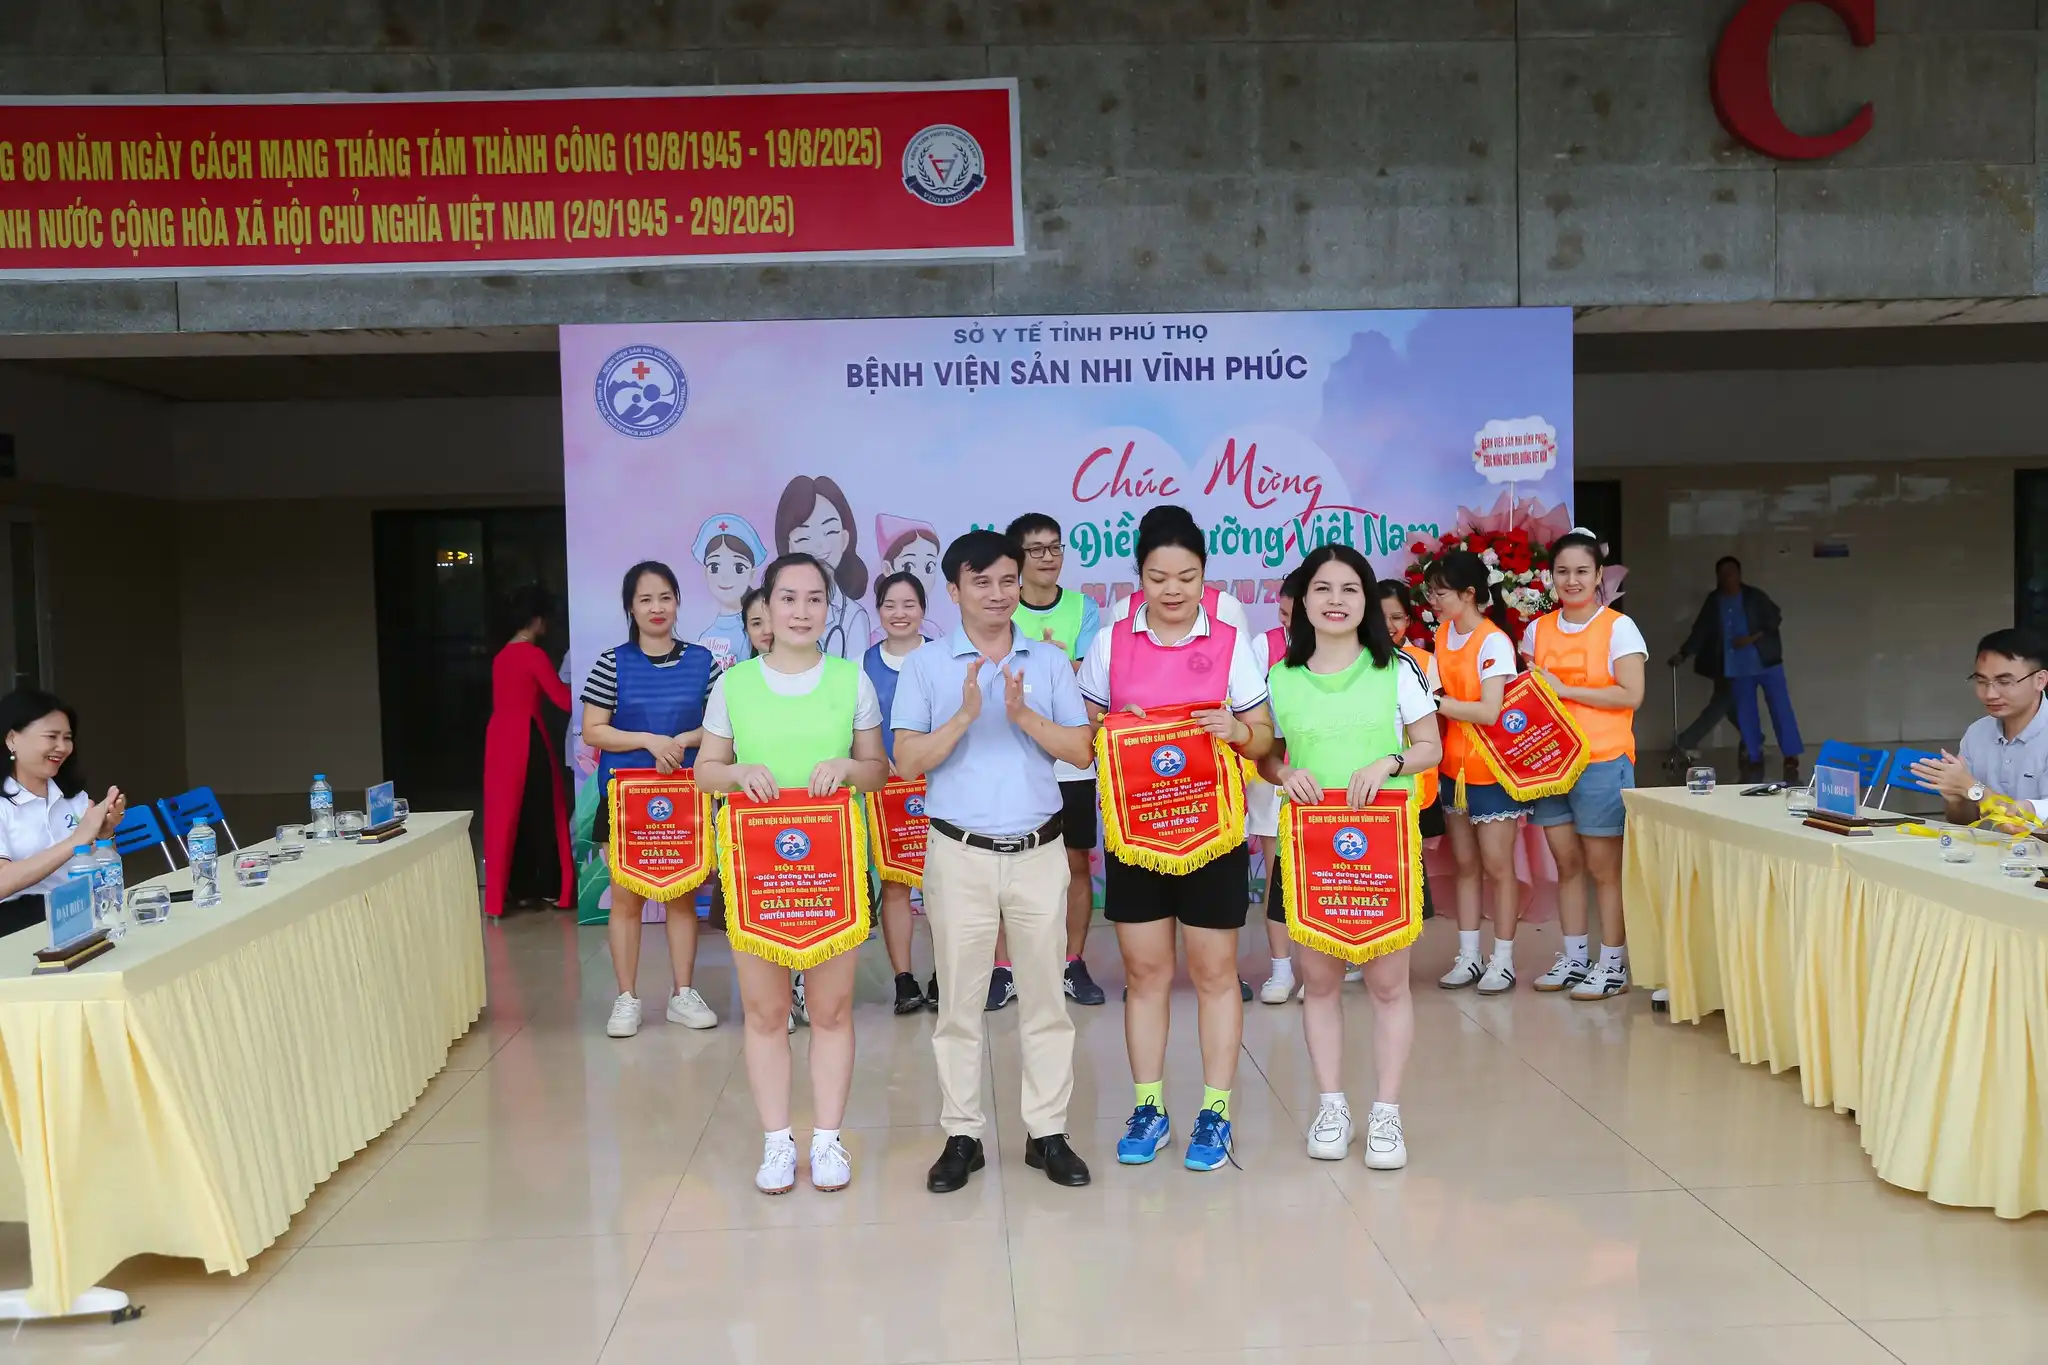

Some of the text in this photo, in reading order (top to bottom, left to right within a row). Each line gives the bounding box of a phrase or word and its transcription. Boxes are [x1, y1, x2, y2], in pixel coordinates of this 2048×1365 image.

[1710, 0, 1876, 160] C
[23, 142, 50, 181] 80
[58, 133, 112, 181] NĂM
[121, 133, 181, 180] NGÀY
[191, 132, 252, 179] CÁCH
[260, 138, 328, 188] MẠNG
[335, 130, 410, 177] THÁNG
[417, 129, 466, 176] TÁM
[473, 127, 547, 175] THÀNH
[555, 125, 616, 173] CÔNG
[625, 131, 741, 177] (19/8/1945
[766, 127, 882, 169] 19/8/2025)
[39, 197, 102, 249] NƯỚC
[111, 201, 174, 257] CỘNG
[182, 198, 227, 247] HÒA
[236, 199, 267, 246] XÃ
[274, 198, 311, 254] HỘI
[319, 188, 363, 244] CHỦ
[372, 197, 442, 244] NGHĨA
[447, 195, 494, 250] VIỆT
[503, 200, 556, 240] NAM
[564, 198, 668, 243] (2/9/1945
[690, 194, 795, 238] 2/9/2025)
[953, 320, 1208, 344] SỞ Y TẾ TỈNH PHÚ THỌ
[847, 347, 1308, 395] BỆNH VIỆN SẢN NHI VĨNH PHÚC
[1072, 438, 1323, 527] Chúc Mừng
[1201, 516, 1283, 567] ưỡng
[1152, 777, 1191, 788] HỘI THI
[1139, 801, 1208, 822] GIẢI NHẤT
[1337, 814, 1349, 822] SẢN
[748, 817, 764, 827] BỆNH
[765, 816, 777, 826] VIỆN
[779, 815, 790, 824] SẢN
[803, 815, 816, 823] VĨNH
[817, 814, 833, 823] PHÚC
[641, 847, 663, 856] GIẢI
[902, 841, 923, 850] GIẢI
[774, 864, 793, 872] HỘI
[1332, 862, 1350, 871] HỘI
[760, 894, 833, 909] GIẢI NHẤT
[1318, 893, 1388, 906] GIẢI NHẤT
